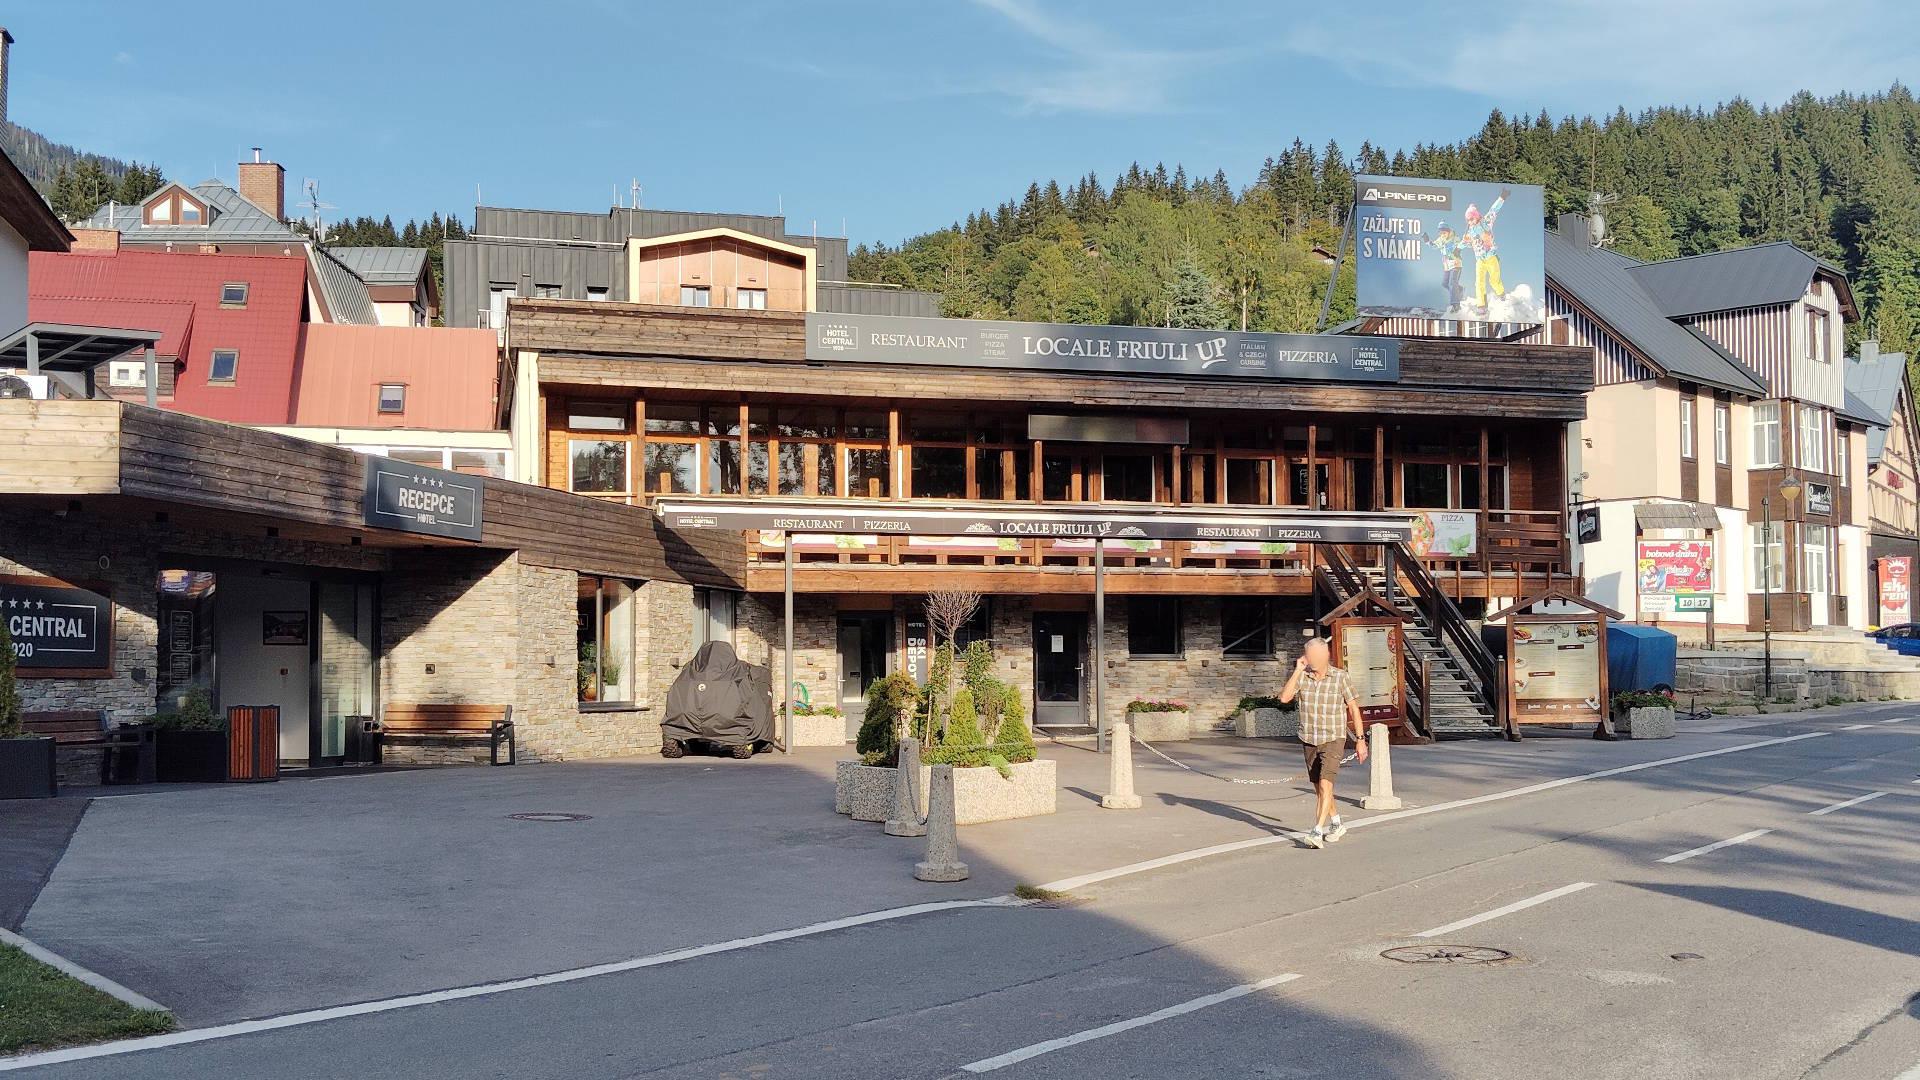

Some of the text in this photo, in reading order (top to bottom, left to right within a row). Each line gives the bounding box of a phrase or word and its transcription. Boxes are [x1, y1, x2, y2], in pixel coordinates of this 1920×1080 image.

[1363, 188, 1447, 203] ALPINE PRO
[1362, 214, 1421, 234] ZAŽIJTE TO
[1363, 235, 1421, 260] S NÁMI!
[826, 329, 850, 337] HOTEL
[822, 337, 855, 346] CENTRAL
[871, 333, 968, 349] RESTAURANT
[1022, 336, 1228, 364] LOCALE FRIULI UP
[1279, 350, 1339, 364] PIZZERIA
[1358, 351, 1380, 359] HOTEL
[1354, 359, 1383, 367] CENTRAL
[398, 487, 455, 515] RECEPCE
[417, 513, 437, 525] HOTEL
[773, 518, 912, 531] RESTAURANT PIZZERIA
[1441, 514, 1465, 522] PIZZA
[999, 521, 1112, 536] LOCALE FRIULI UP
[1196, 527, 1321, 539] RESTAURANT PIZZERIA
[1882, 577, 1907, 592] ski
[1882, 591, 1908, 600] rent
[1682, 599, 1693, 607] 10
[1697, 599, 1708, 607] 17
[9, 615, 87, 638] CENTRAL
[917, 638, 927, 659] SKI
[907, 637, 917, 681] DEPOT
